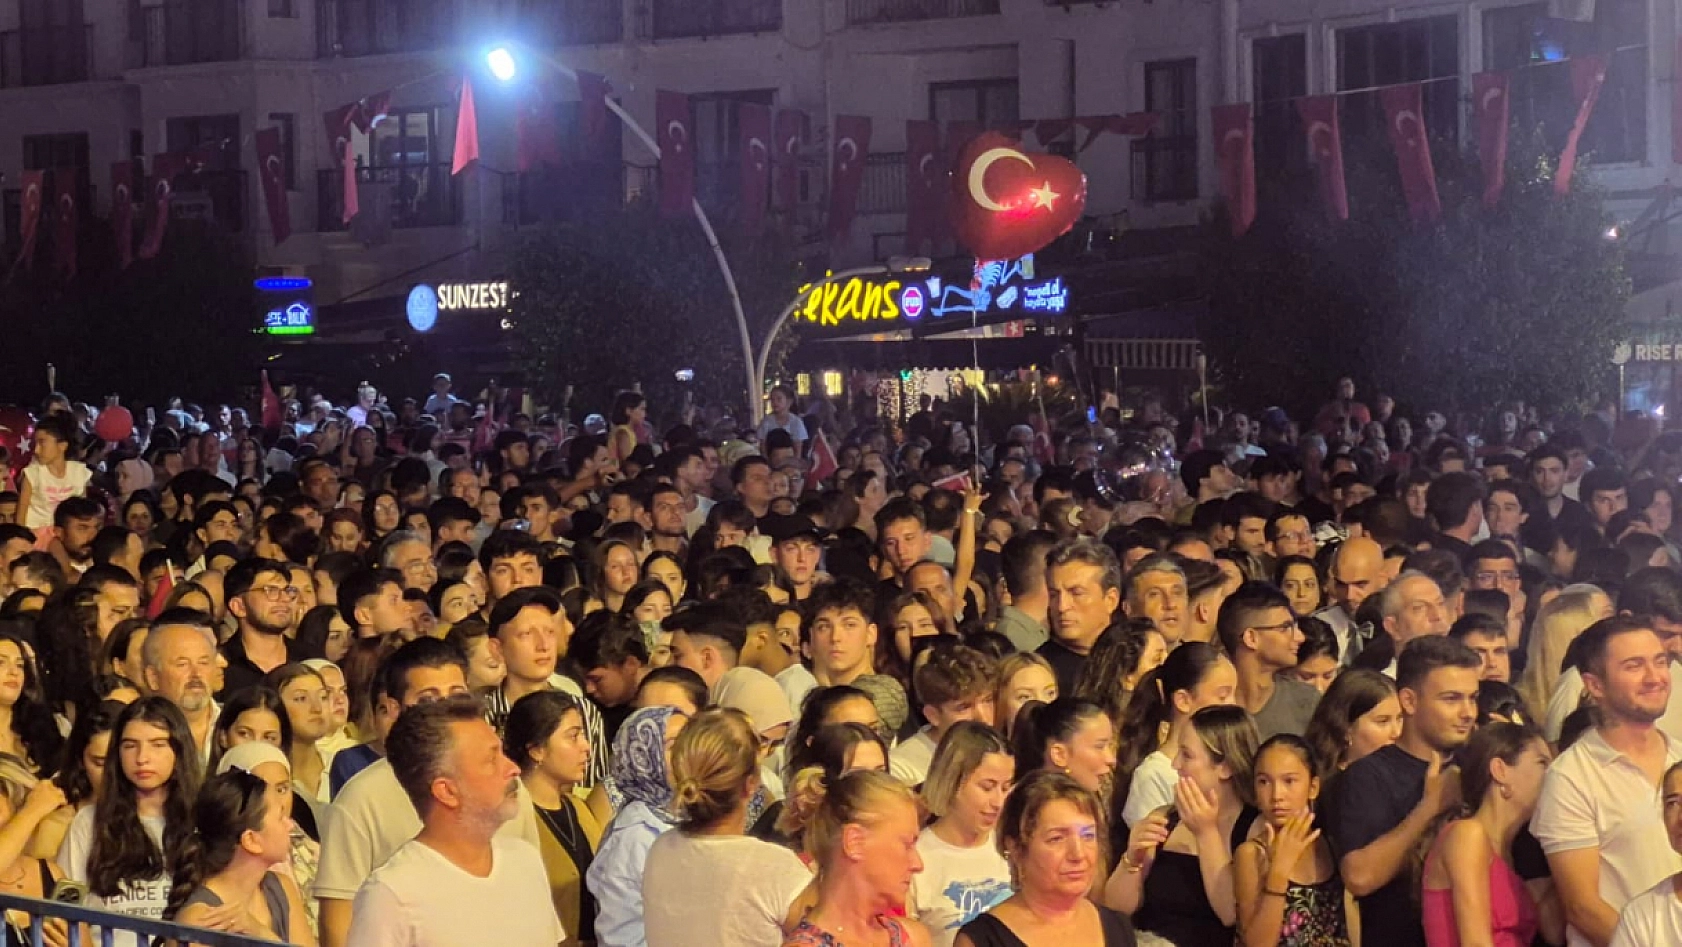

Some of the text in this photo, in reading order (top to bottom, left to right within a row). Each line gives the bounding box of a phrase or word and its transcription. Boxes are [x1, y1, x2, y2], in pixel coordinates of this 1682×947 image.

[437, 282, 508, 310] SUNZEST
[794, 269, 900, 326] ekans
[1635, 344, 1672, 361] RISE
